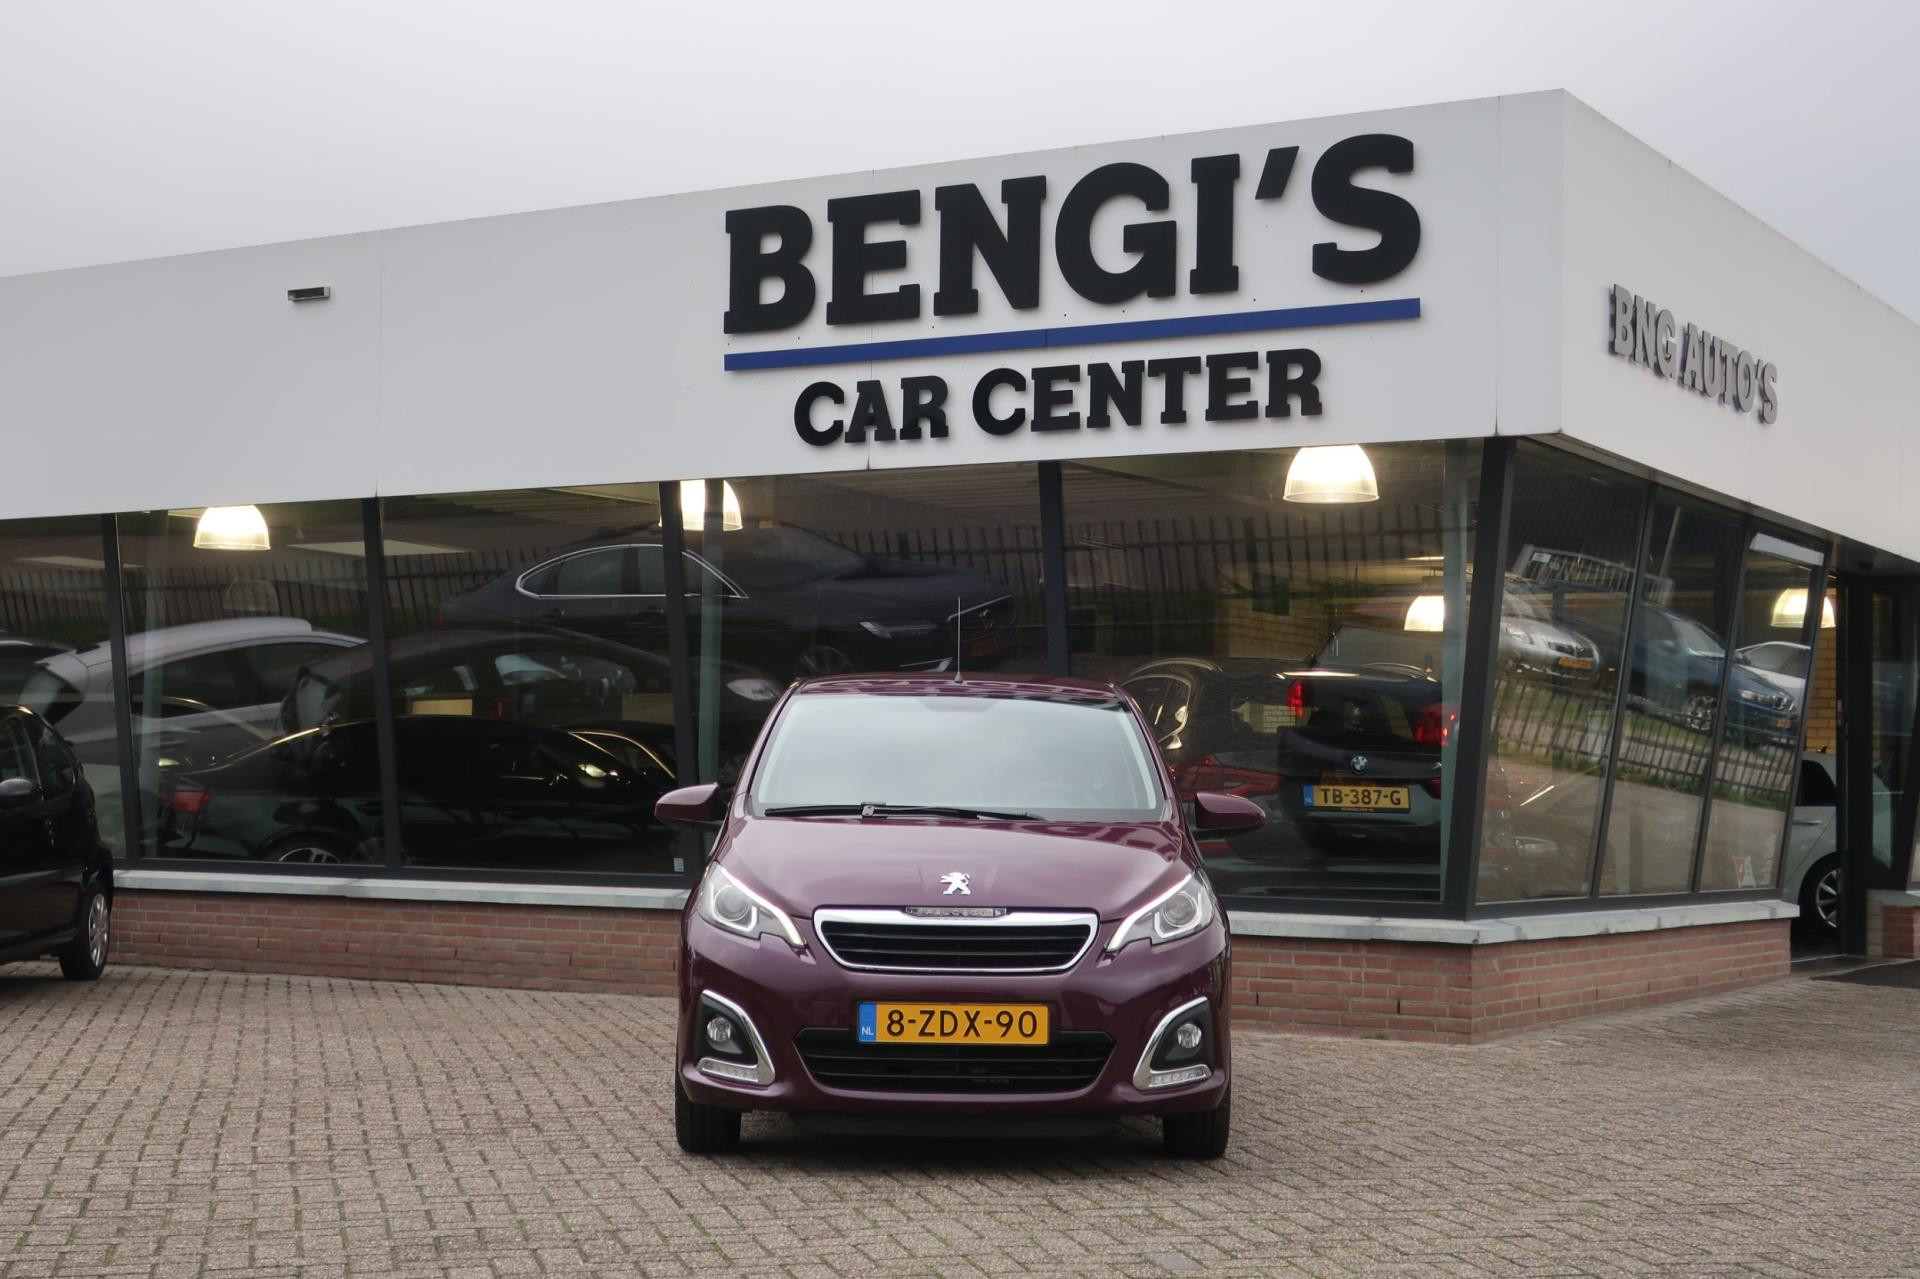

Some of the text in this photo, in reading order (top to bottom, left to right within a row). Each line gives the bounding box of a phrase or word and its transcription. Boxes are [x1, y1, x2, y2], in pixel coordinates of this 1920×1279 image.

[724, 133, 1421, 334] BENGI'S
[794, 348, 1323, 447] CAR CENTER
[1610, 283, 1778, 424] BNG AUTO'S
[1320, 788, 1402, 806] TB-387-G
[861, 1009, 1038, 1038] NL 8-ZDX-90
